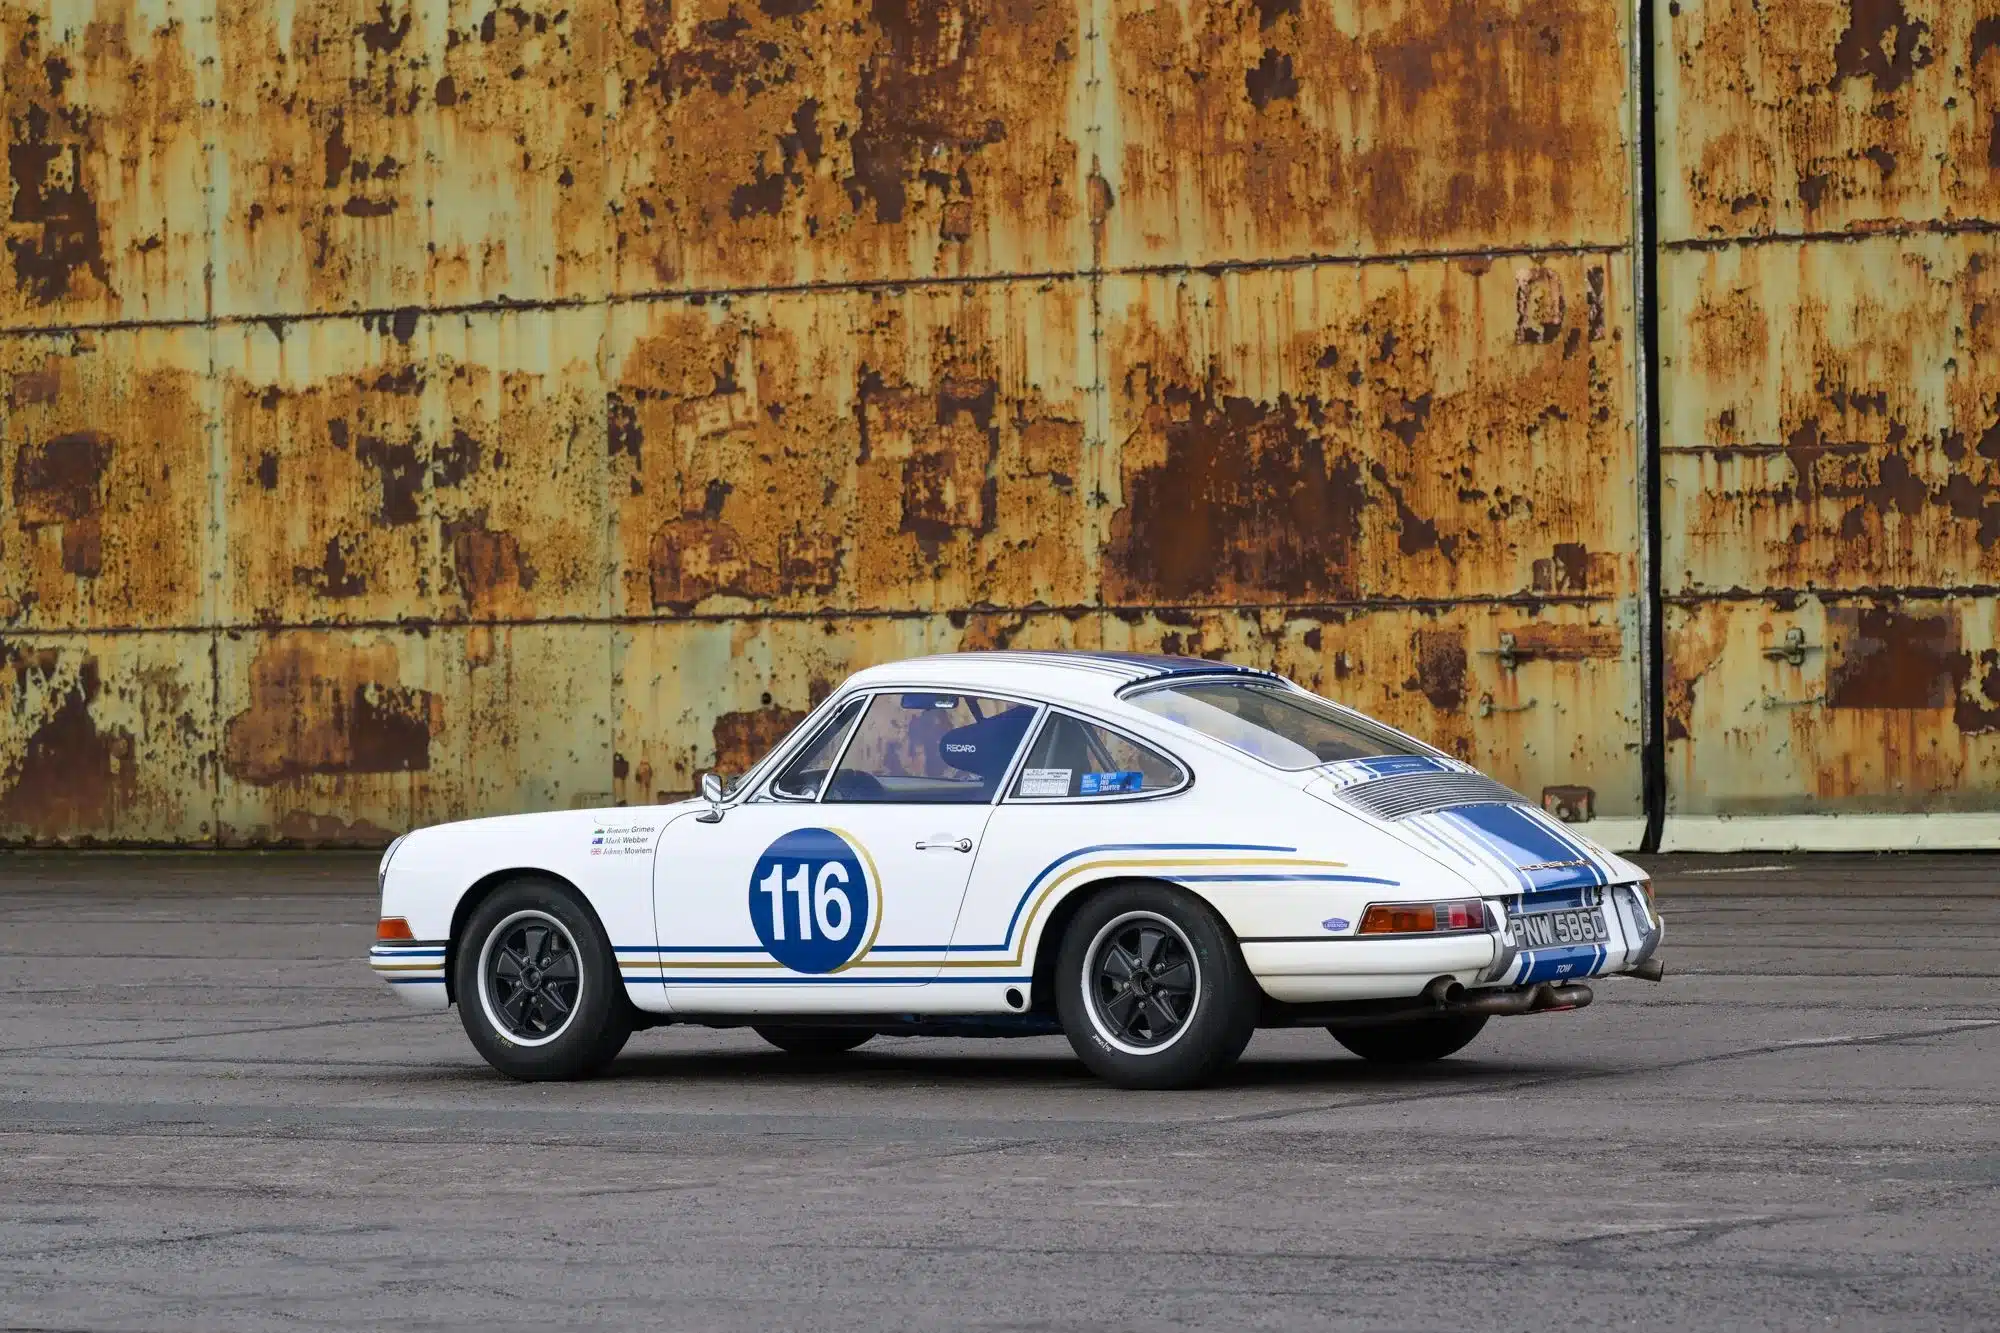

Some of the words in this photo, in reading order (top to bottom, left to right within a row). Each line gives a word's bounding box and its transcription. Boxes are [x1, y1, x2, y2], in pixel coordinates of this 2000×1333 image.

[946, 743, 976, 753] RECARO
[631, 825, 655, 833] Grimes
[605, 836, 621, 844] Mark
[622, 836, 648, 844] Webber
[624, 847, 653, 855] Mowlem
[759, 860, 852, 942] 116
[1511, 914, 1553, 948] PNW
[1555, 963, 1574, 974] TOW
